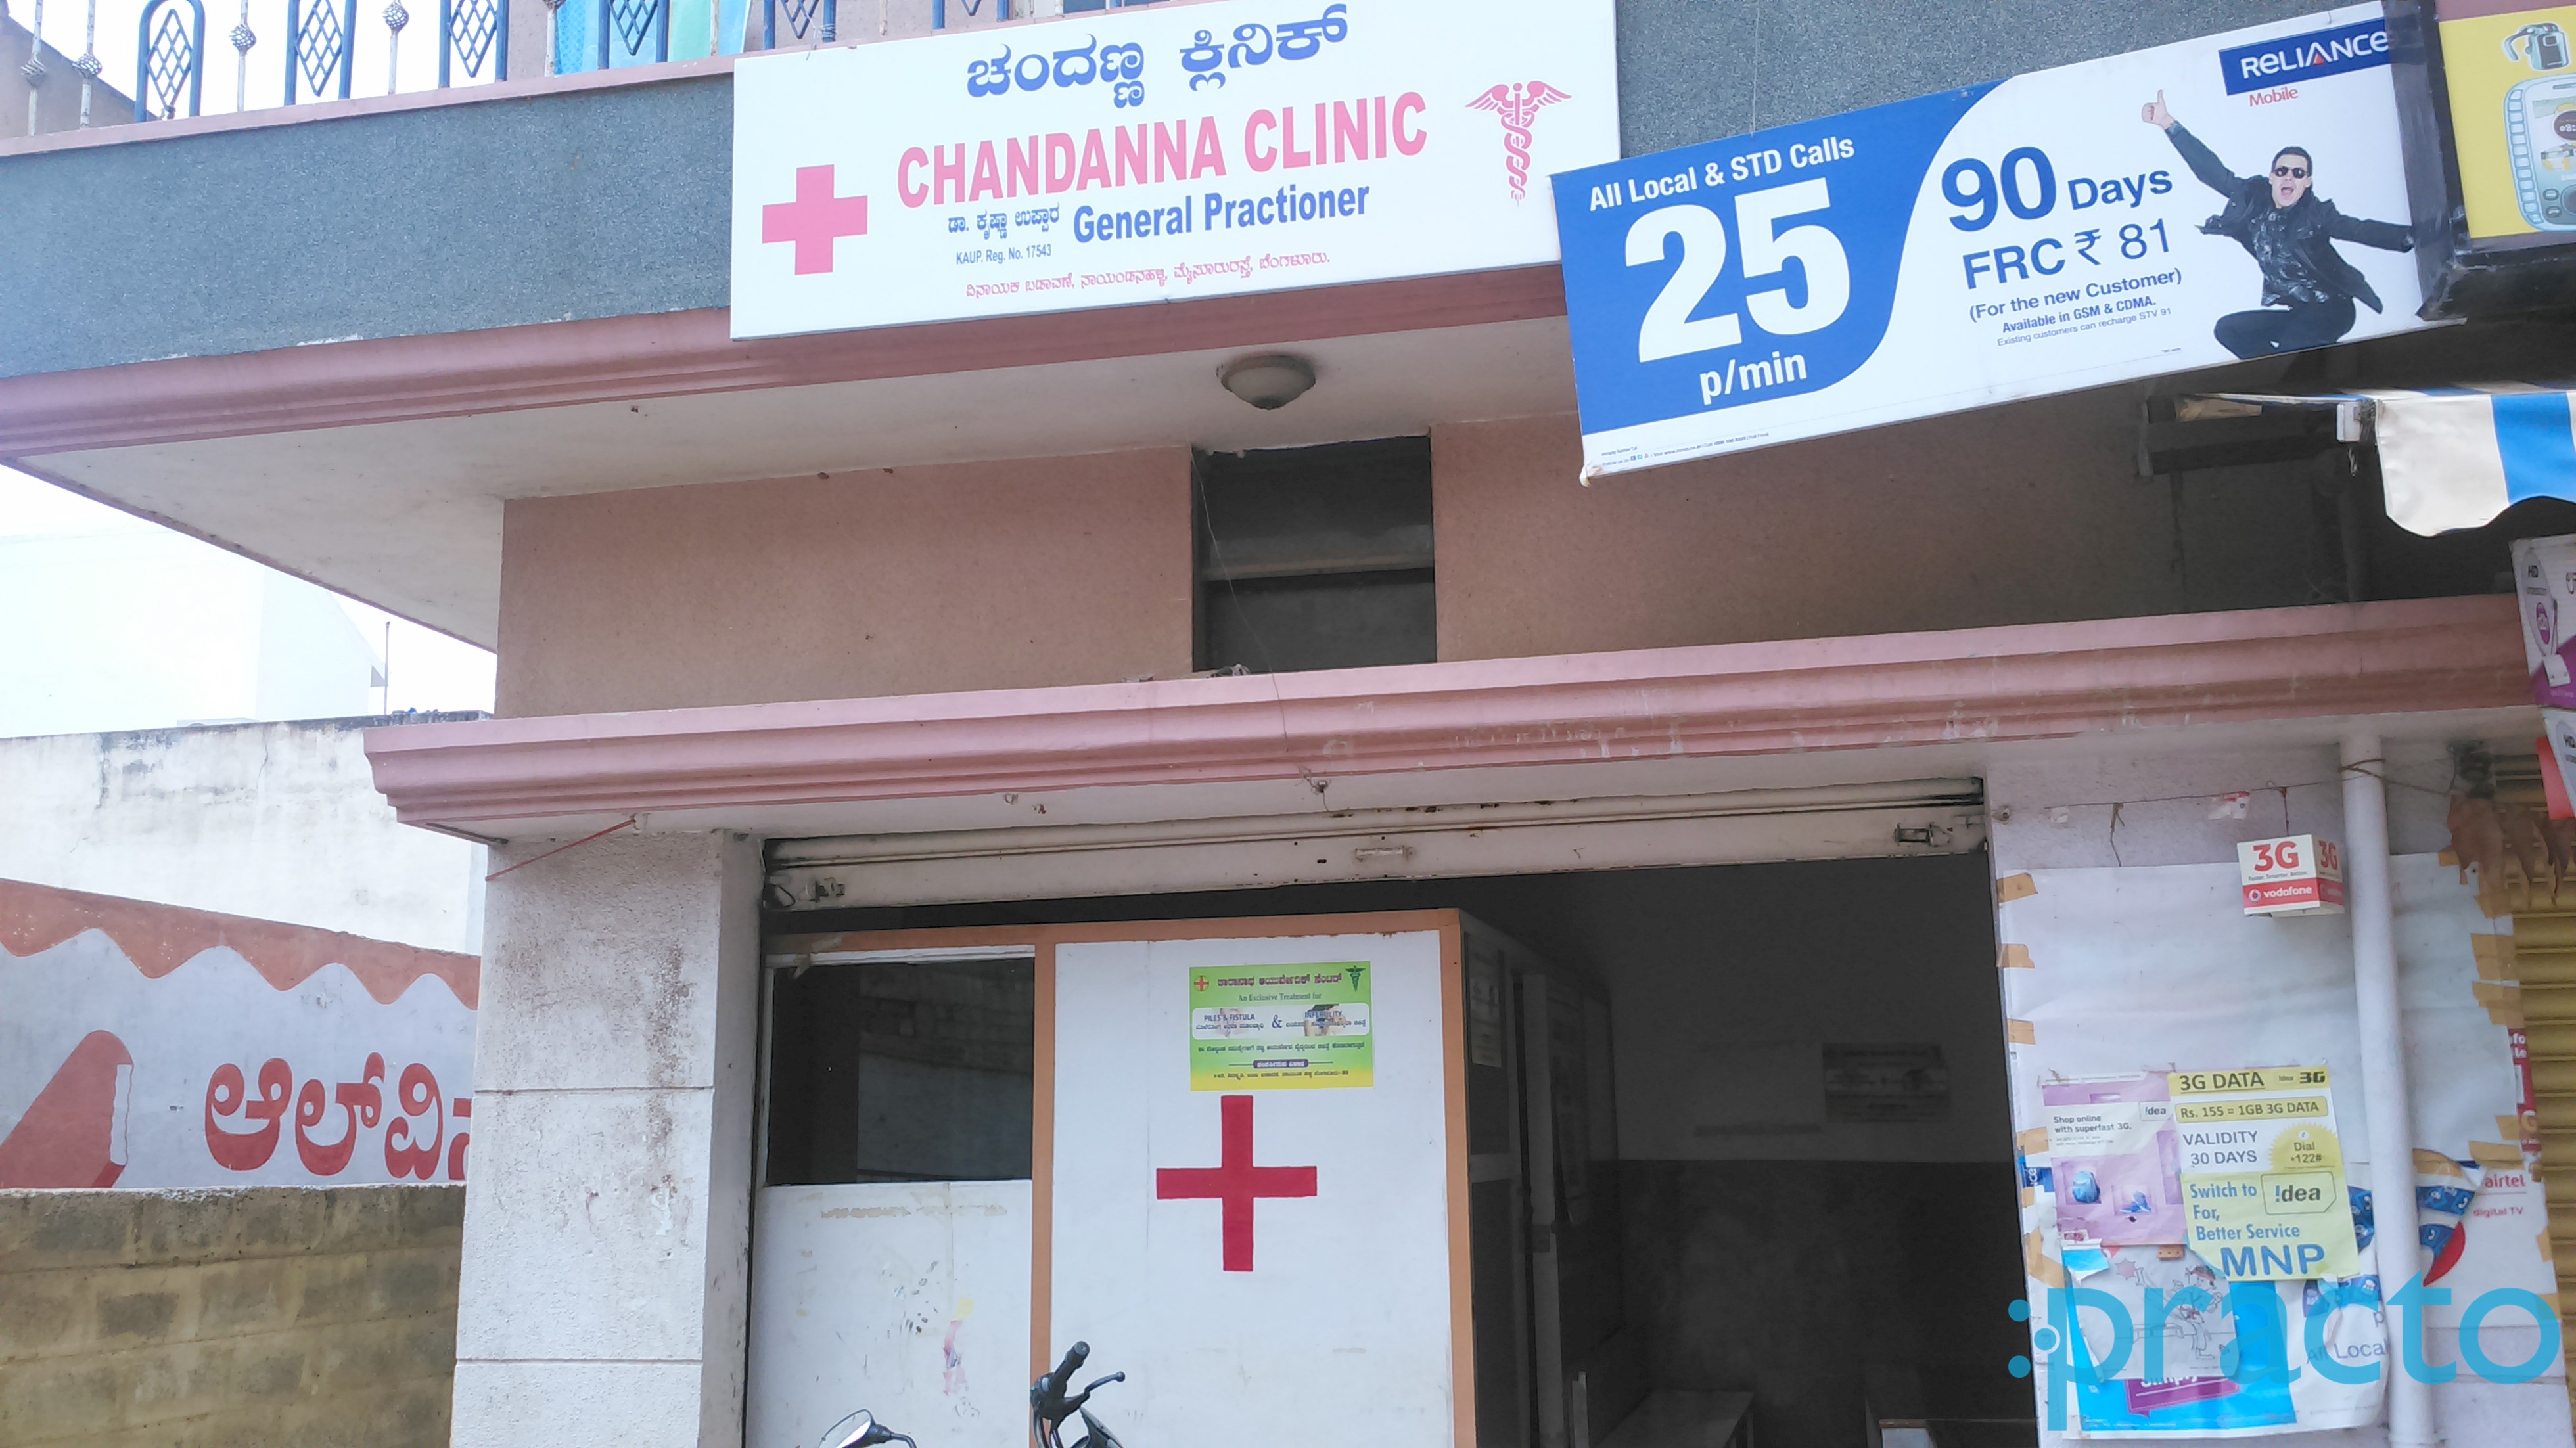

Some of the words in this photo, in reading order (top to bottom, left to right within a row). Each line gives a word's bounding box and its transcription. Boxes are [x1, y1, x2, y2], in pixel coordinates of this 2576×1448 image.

[967, 33, 1145, 108] ಚಂದಣ್ಣ
[1180, 3, 1348, 92] ಕ್ಲಿನಿಕ್
[2249, 87, 2299, 107] Mobile
[897, 116, 1228, 208] CHANDANNA
[1244, 91, 1428, 173] CLINIC
[1590, 183, 1622, 211] All
[1628, 166, 1697, 202] Local
[1705, 164, 1725, 187] &
[1730, 149, 1782, 181] STD
[1789, 136, 1855, 168] Calls
[1941, 146, 2057, 232] 90
[2067, 170, 2173, 210] Days
[1074, 195, 1192, 244] General
[1204, 183, 1371, 232] Practioner
[948, 215, 969, 234] ಡಾ.
[956, 250, 983, 265] KAUP.
[986, 248, 1006, 264] Reg.
[1008, 247, 1023, 261] No.
[1026, 243, 1052, 258] 17543
[1962, 238, 2066, 290] FRC
[2119, 217, 2169, 259] 81
[1624, 177, 1851, 363] 25
[1969, 303, 2006, 323] (For
[2010, 296, 2040, 312] the
[2044, 289, 2081, 305] new
[2086, 267, 2182, 298] Customer)
[2002, 314, 2056, 333] Available
[2059, 312, 2070, 323] in
[2073, 305, 2100, 320] GSM
[2104, 302, 2113, 314] &
[2116, 295, 2157, 312] CDMA.
[1997, 334, 2031, 346] Existing
[2033, 325, 2078, 340] customers
[2080, 321, 2096, 332] can
[2098, 313, 2137, 328] recharge
[2139, 309, 2158, 320] STV
[2160, 307, 2171, 317] 91
[1699, 351, 1808, 405] p/min
[2253, 841, 2299, 872] 3G
[2318, 840, 2338, 870] 3G
[2263, 886, 2312, 899] vodafone
[1272, 1014, 1283, 1028] &
[2180, 1074, 2206, 1091] 3G
[2213, 1072, 2265, 1089] DATA
[2300, 1072, 2325, 1084] 3G
[2180, 1108, 2198, 1118] Rs.
[2202, 1106, 2224, 1117] 155
[2238, 1104, 2263, 1116] 1GB
[2267, 1103, 2283, 1114] 3G
[2288, 1102, 2319, 1112] DATA
[2075, 1124, 2115, 1133] superfast
[2182, 1131, 2257, 1146] VALIDITY
[2293, 1142, 2315, 1151] Dial
[2191, 1152, 2209, 1165] 30
[2215, 1150, 2257, 1164] DAYS
[2190, 1181, 2237, 1199] Switch
[2242, 1183, 2257, 1196] to
[2485, 1174, 2526, 1188] airtel
[2193, 1204, 2220, 1221] For,
[2473, 1208, 2507, 1218] digital
[2510, 1207, 2523, 1215] TV
[2196, 1225, 2242, 1241] Better
[2246, 1223, 2300, 1239] Service
[2220, 1244, 2325, 1277] MNP
